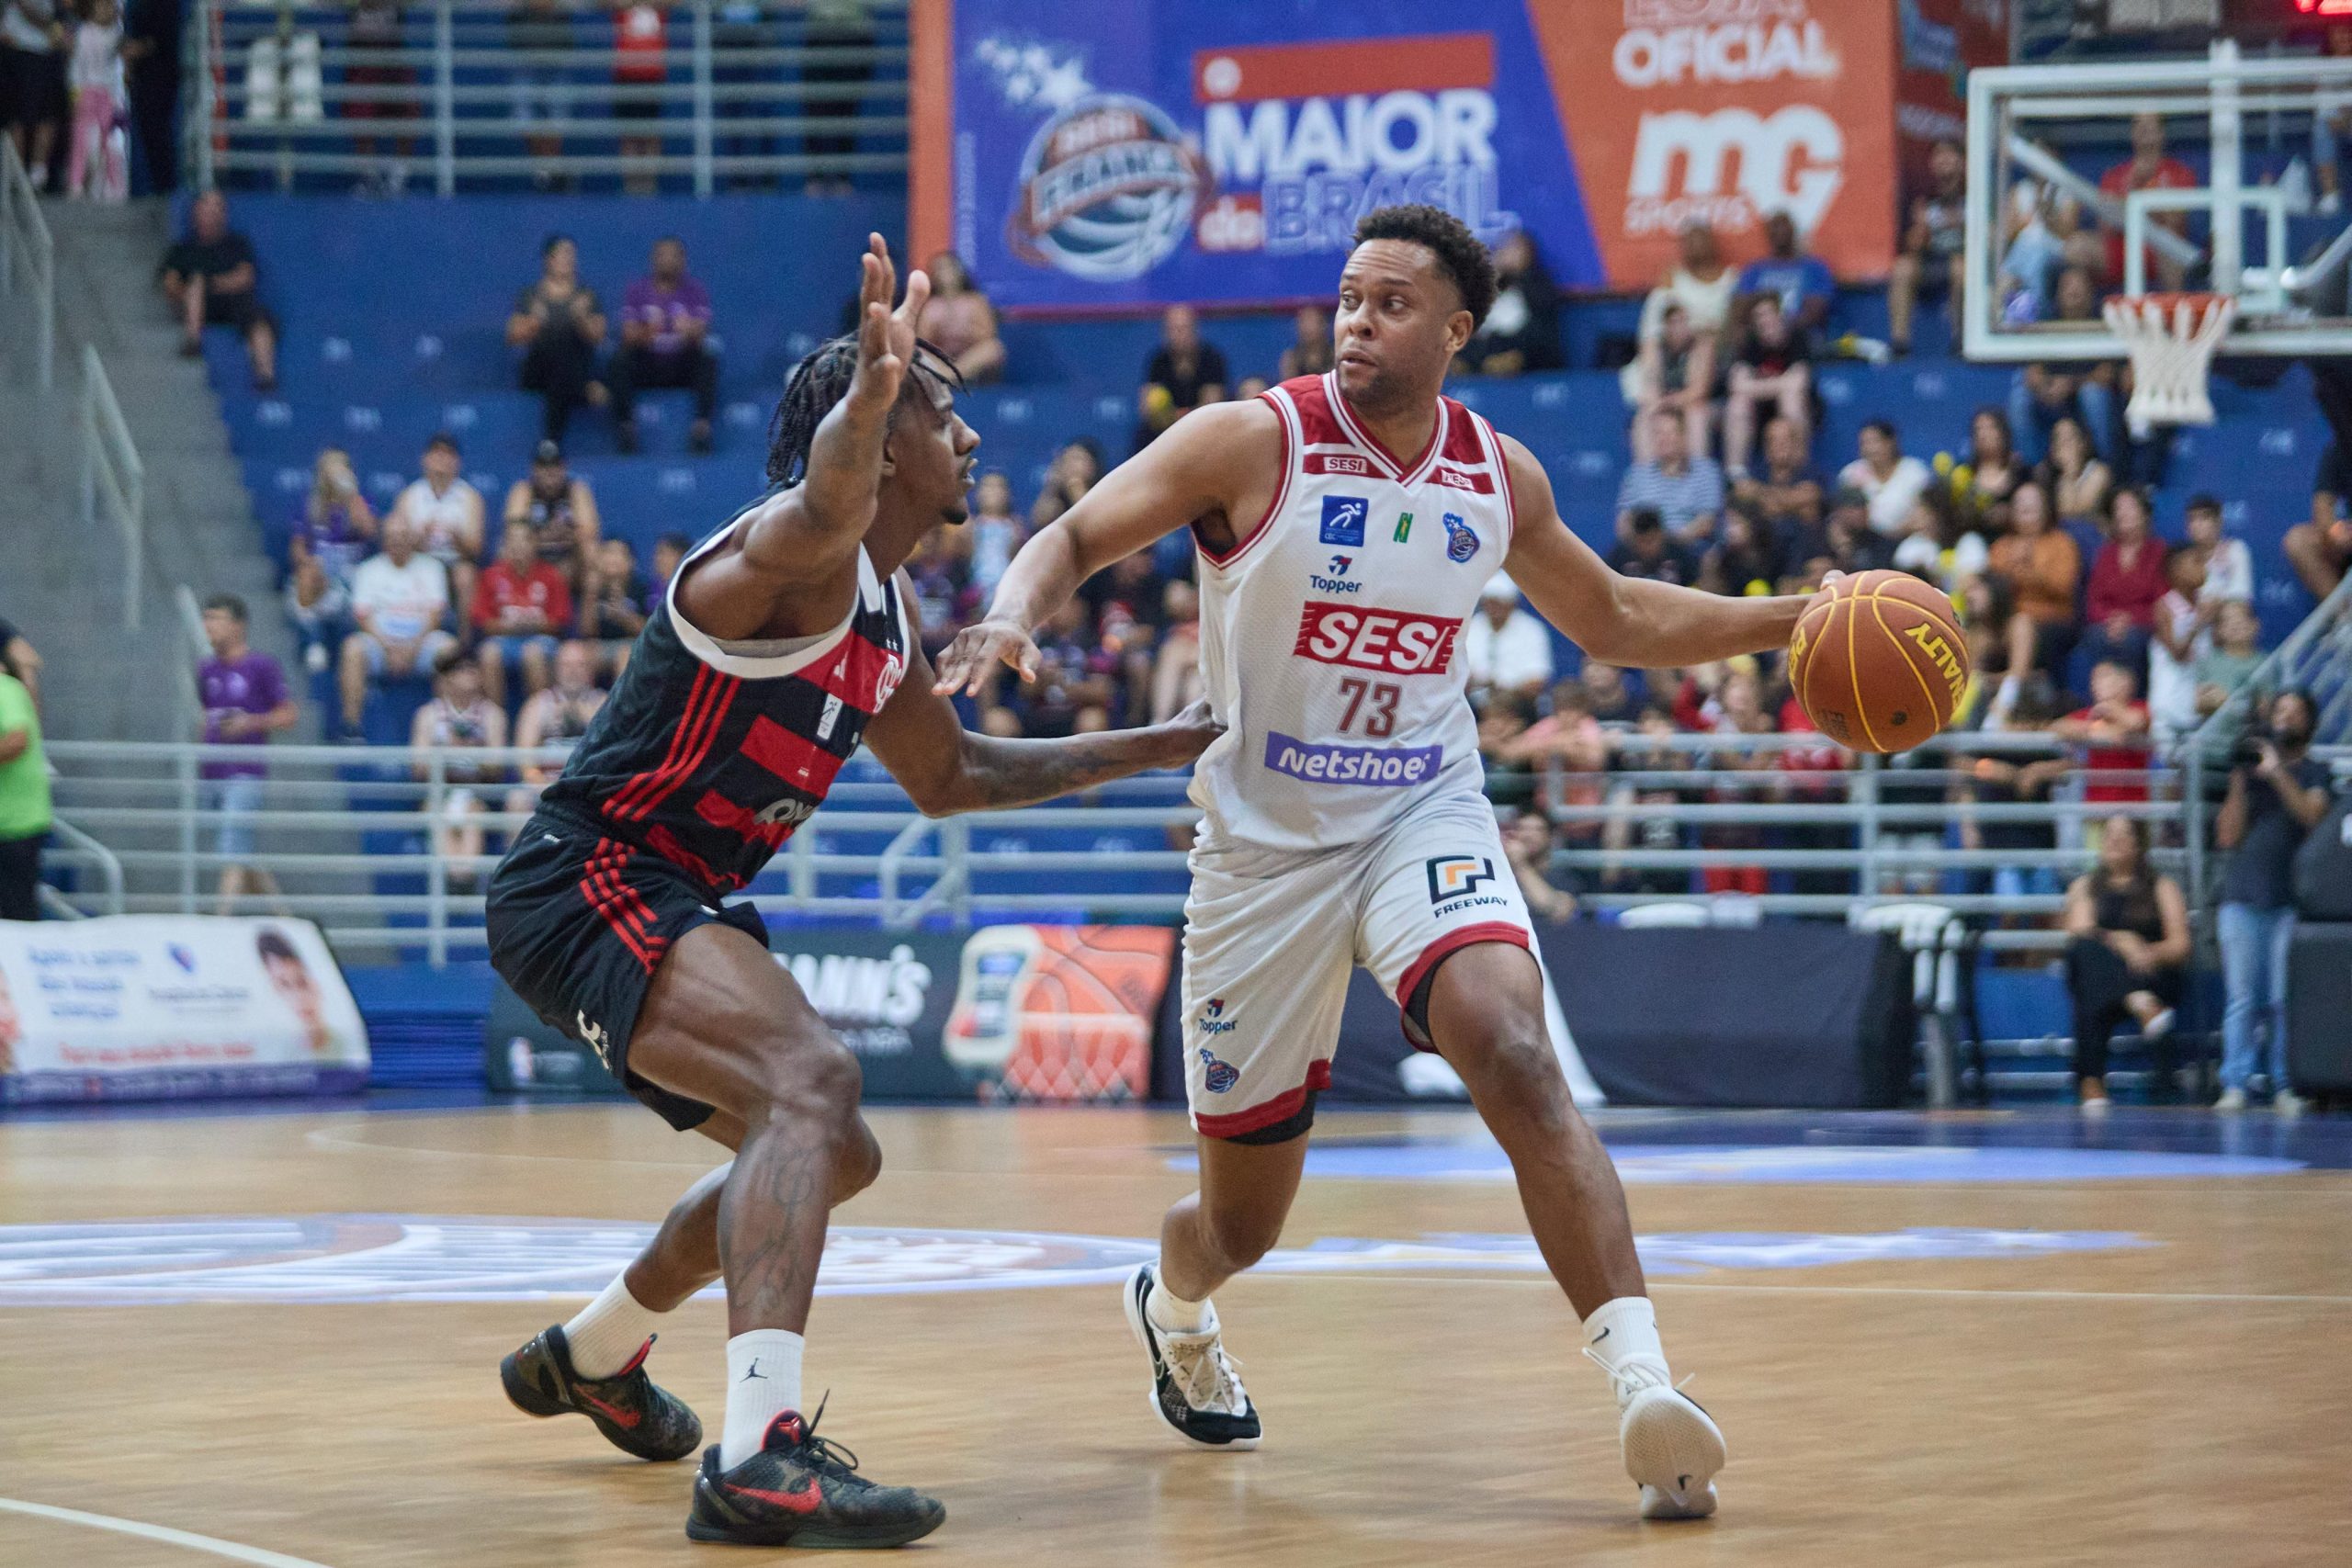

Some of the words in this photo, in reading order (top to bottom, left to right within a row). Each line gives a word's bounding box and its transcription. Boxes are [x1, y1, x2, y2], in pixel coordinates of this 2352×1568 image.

[1612, 18, 1841, 88] OFICIAL
[1204, 88, 1499, 182] MAIOR
[1329, 458, 1363, 471] SESI
[1309, 574, 1363, 593] Topper
[1309, 611, 1451, 671] SESI
[1335, 675, 1403, 738] 73
[1278, 747, 1430, 780] Netshoe
[1433, 896, 1508, 919] FREEWAY
